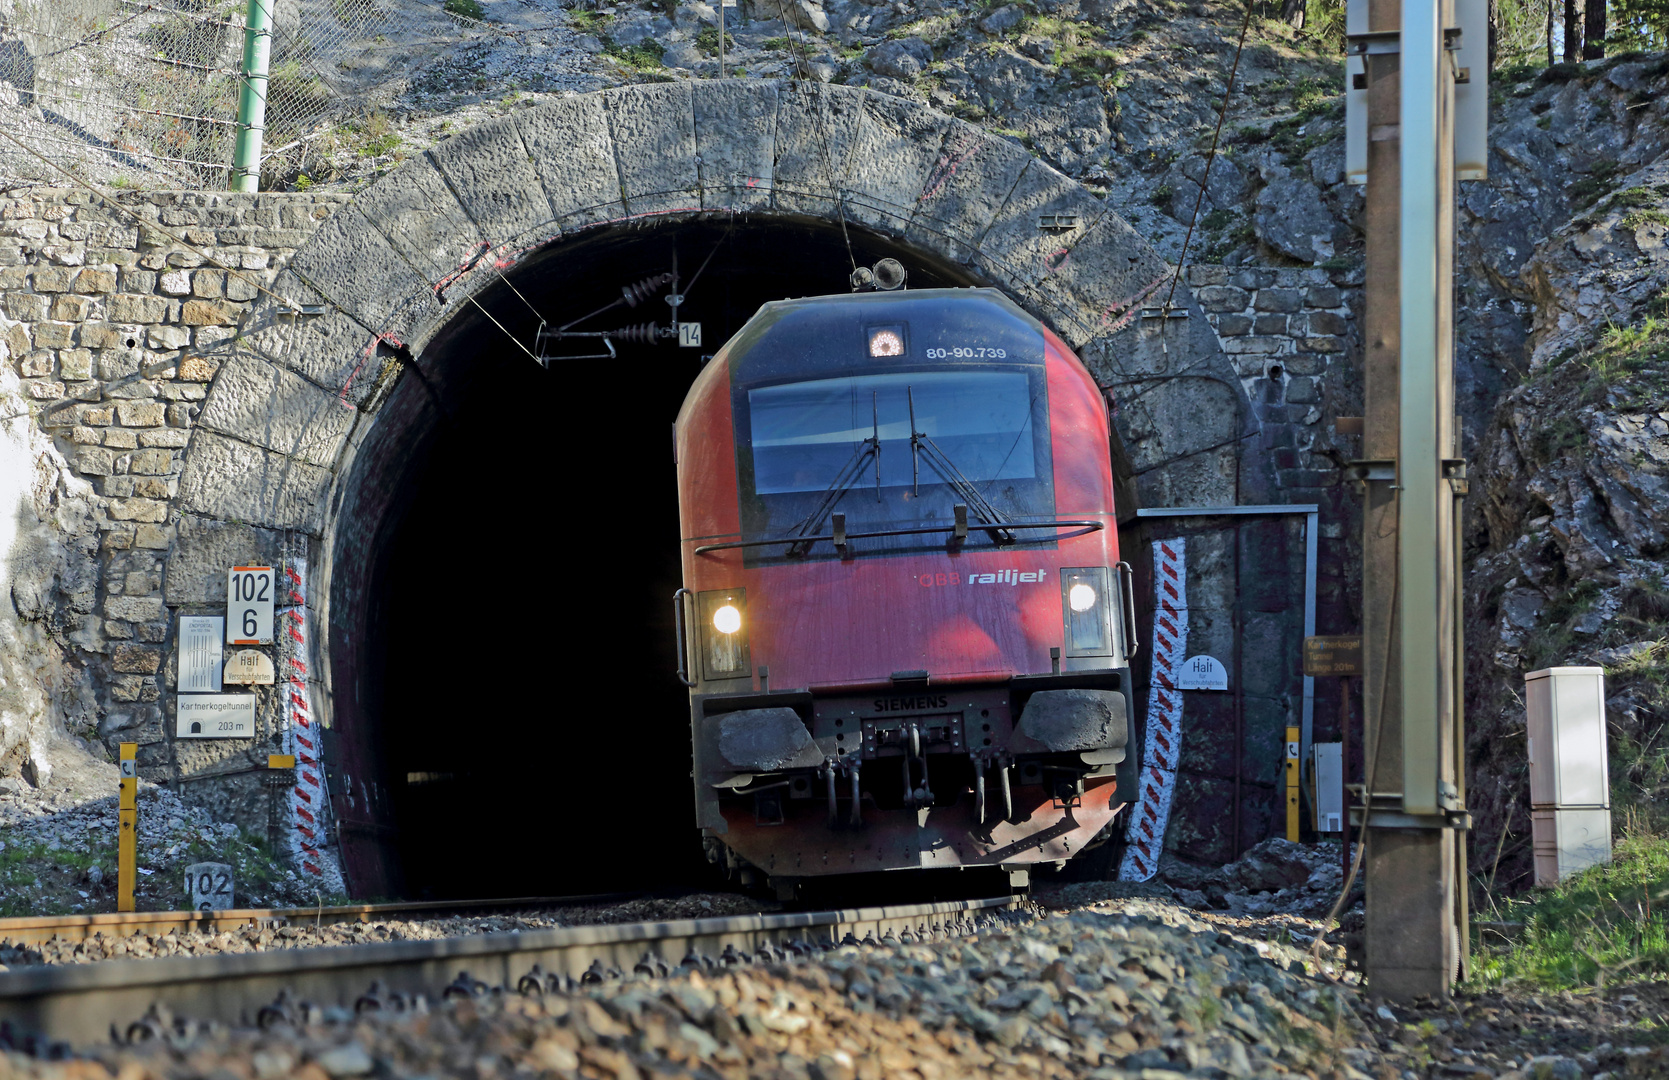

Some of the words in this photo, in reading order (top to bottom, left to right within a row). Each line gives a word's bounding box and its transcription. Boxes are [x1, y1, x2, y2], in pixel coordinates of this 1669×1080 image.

[682, 325, 699, 345] 14
[926, 347, 1007, 359] 80-90.739
[232, 573, 270, 602] 102
[919, 572, 961, 588] ÖBB
[968, 569, 1047, 586] railjet
[242, 608, 258, 638] 6
[240, 655, 259, 666] Halt
[1193, 661, 1213, 673] Halt
[228, 673, 271, 681] Verschubfahrten
[874, 695, 948, 713] SIEMENS
[218, 721, 234, 731] 203
[235, 723, 244, 731] m
[187, 872, 230, 895] 102
